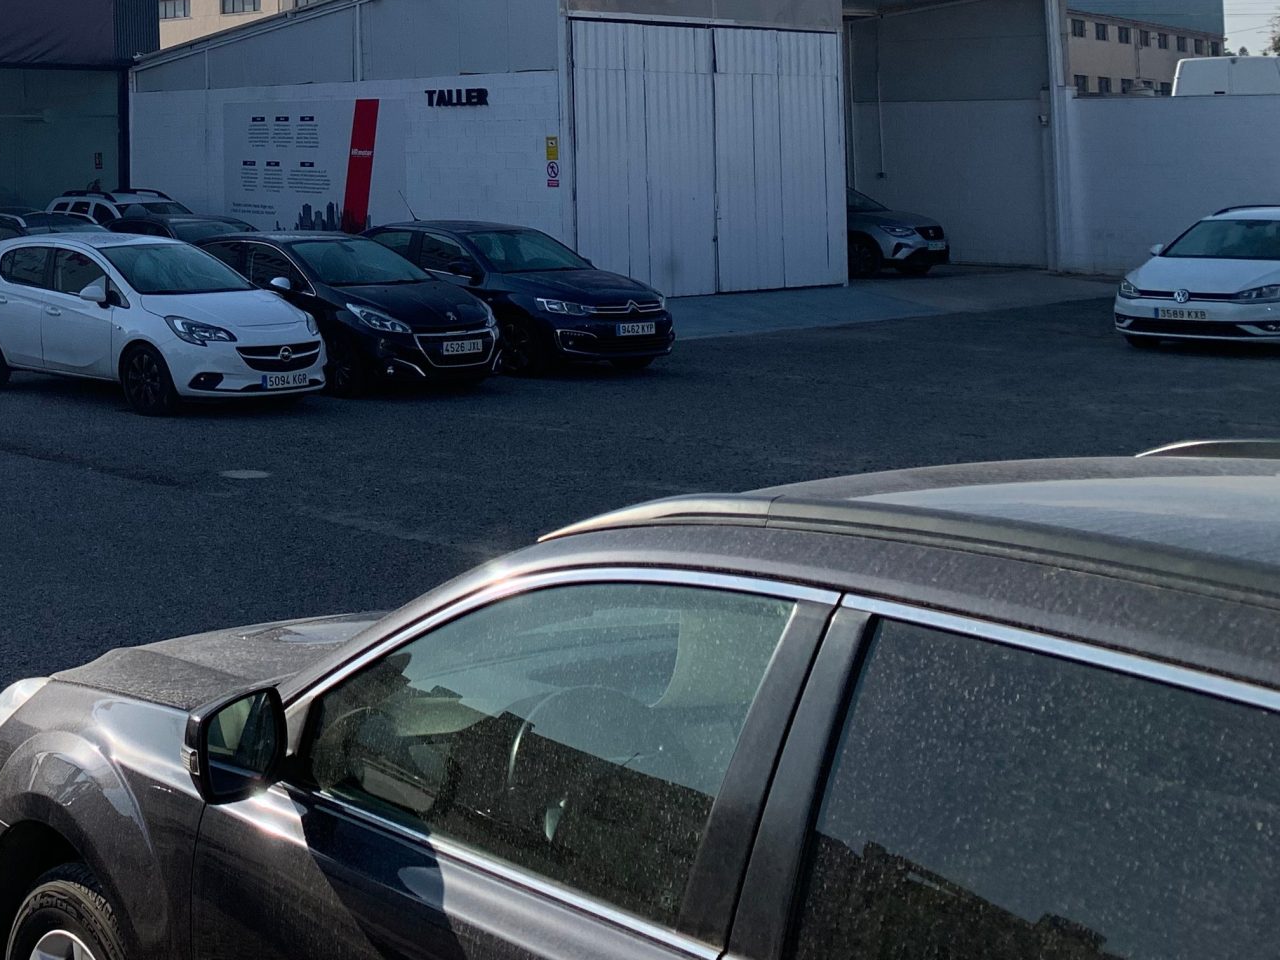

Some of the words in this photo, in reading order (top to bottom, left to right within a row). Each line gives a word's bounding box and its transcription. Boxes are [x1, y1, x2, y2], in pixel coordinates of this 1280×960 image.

[424, 88, 489, 107] TALLER
[1160, 309, 1185, 318] 3589
[621, 325, 640, 334] 9462
[445, 343, 466, 352] 4526
[468, 341, 481, 351] JXL
[268, 375, 291, 386] 5094
[292, 373, 308, 384] KGR
